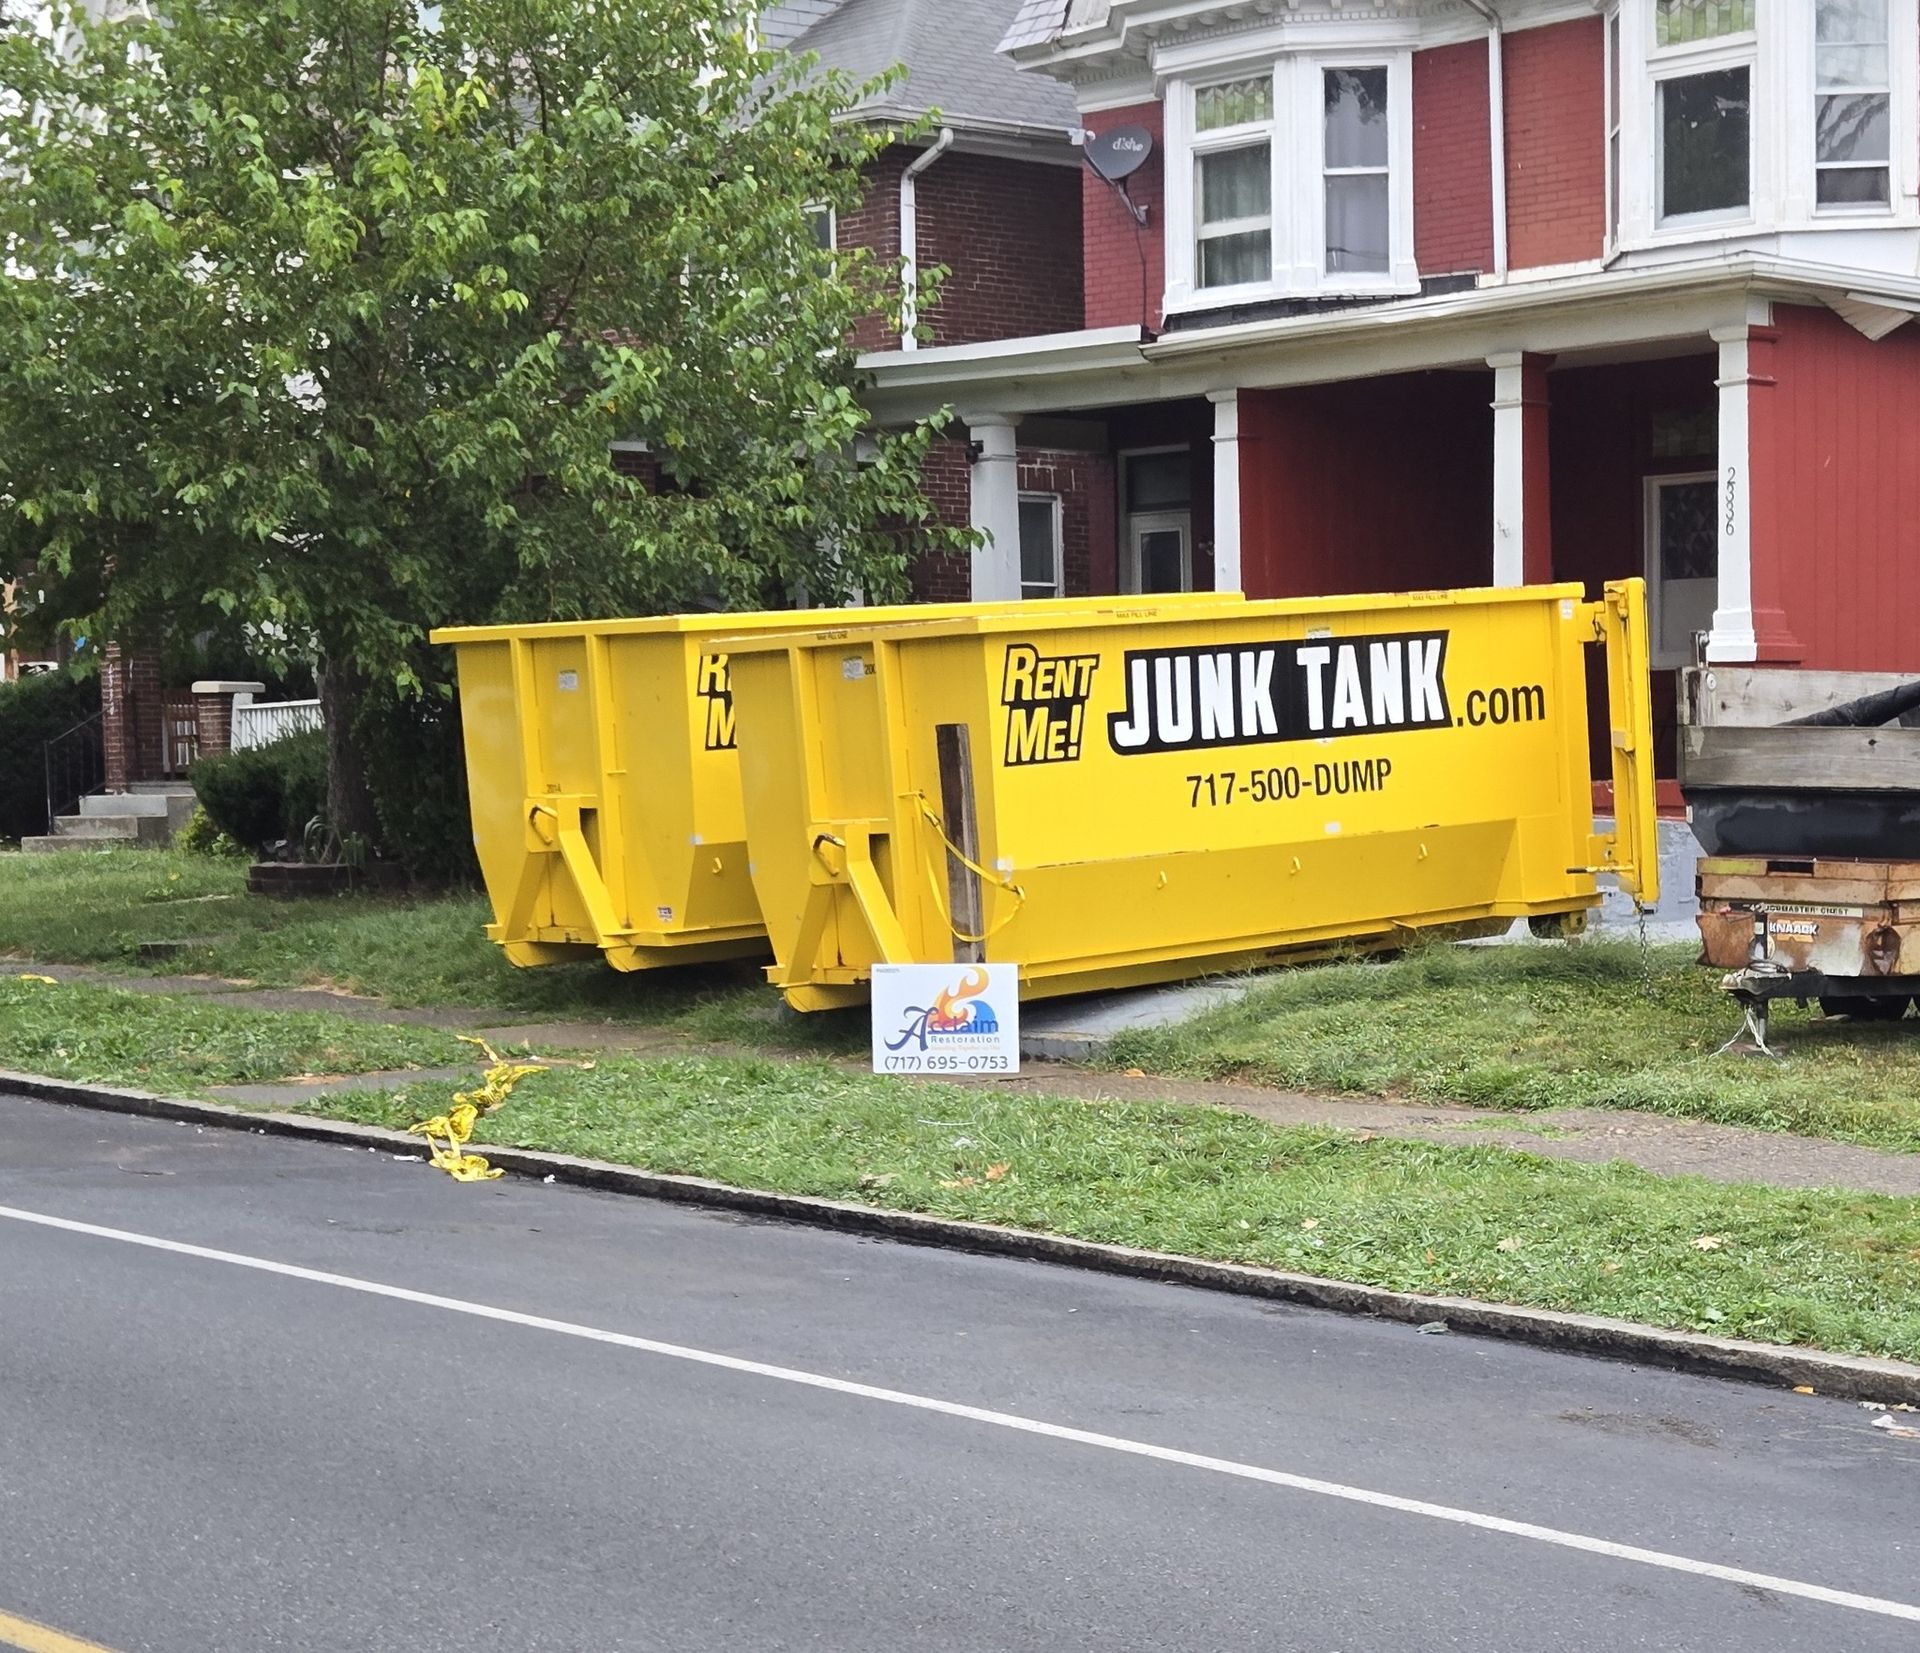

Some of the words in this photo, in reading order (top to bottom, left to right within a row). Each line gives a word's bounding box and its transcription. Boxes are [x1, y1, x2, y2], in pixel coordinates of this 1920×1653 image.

[1725, 466, 1736, 536] 2336
[1114, 650, 1279, 747] JUNK
[1296, 638, 1445, 732] TANK
[1186, 758, 1392, 808] 717-500-DUMP
[884, 1006, 999, 1051] Acclaim
[931, 1035, 1000, 1044] Restoration
[885, 1056, 922, 1070] (717)
[927, 1056, 1009, 1070] 695-0753
